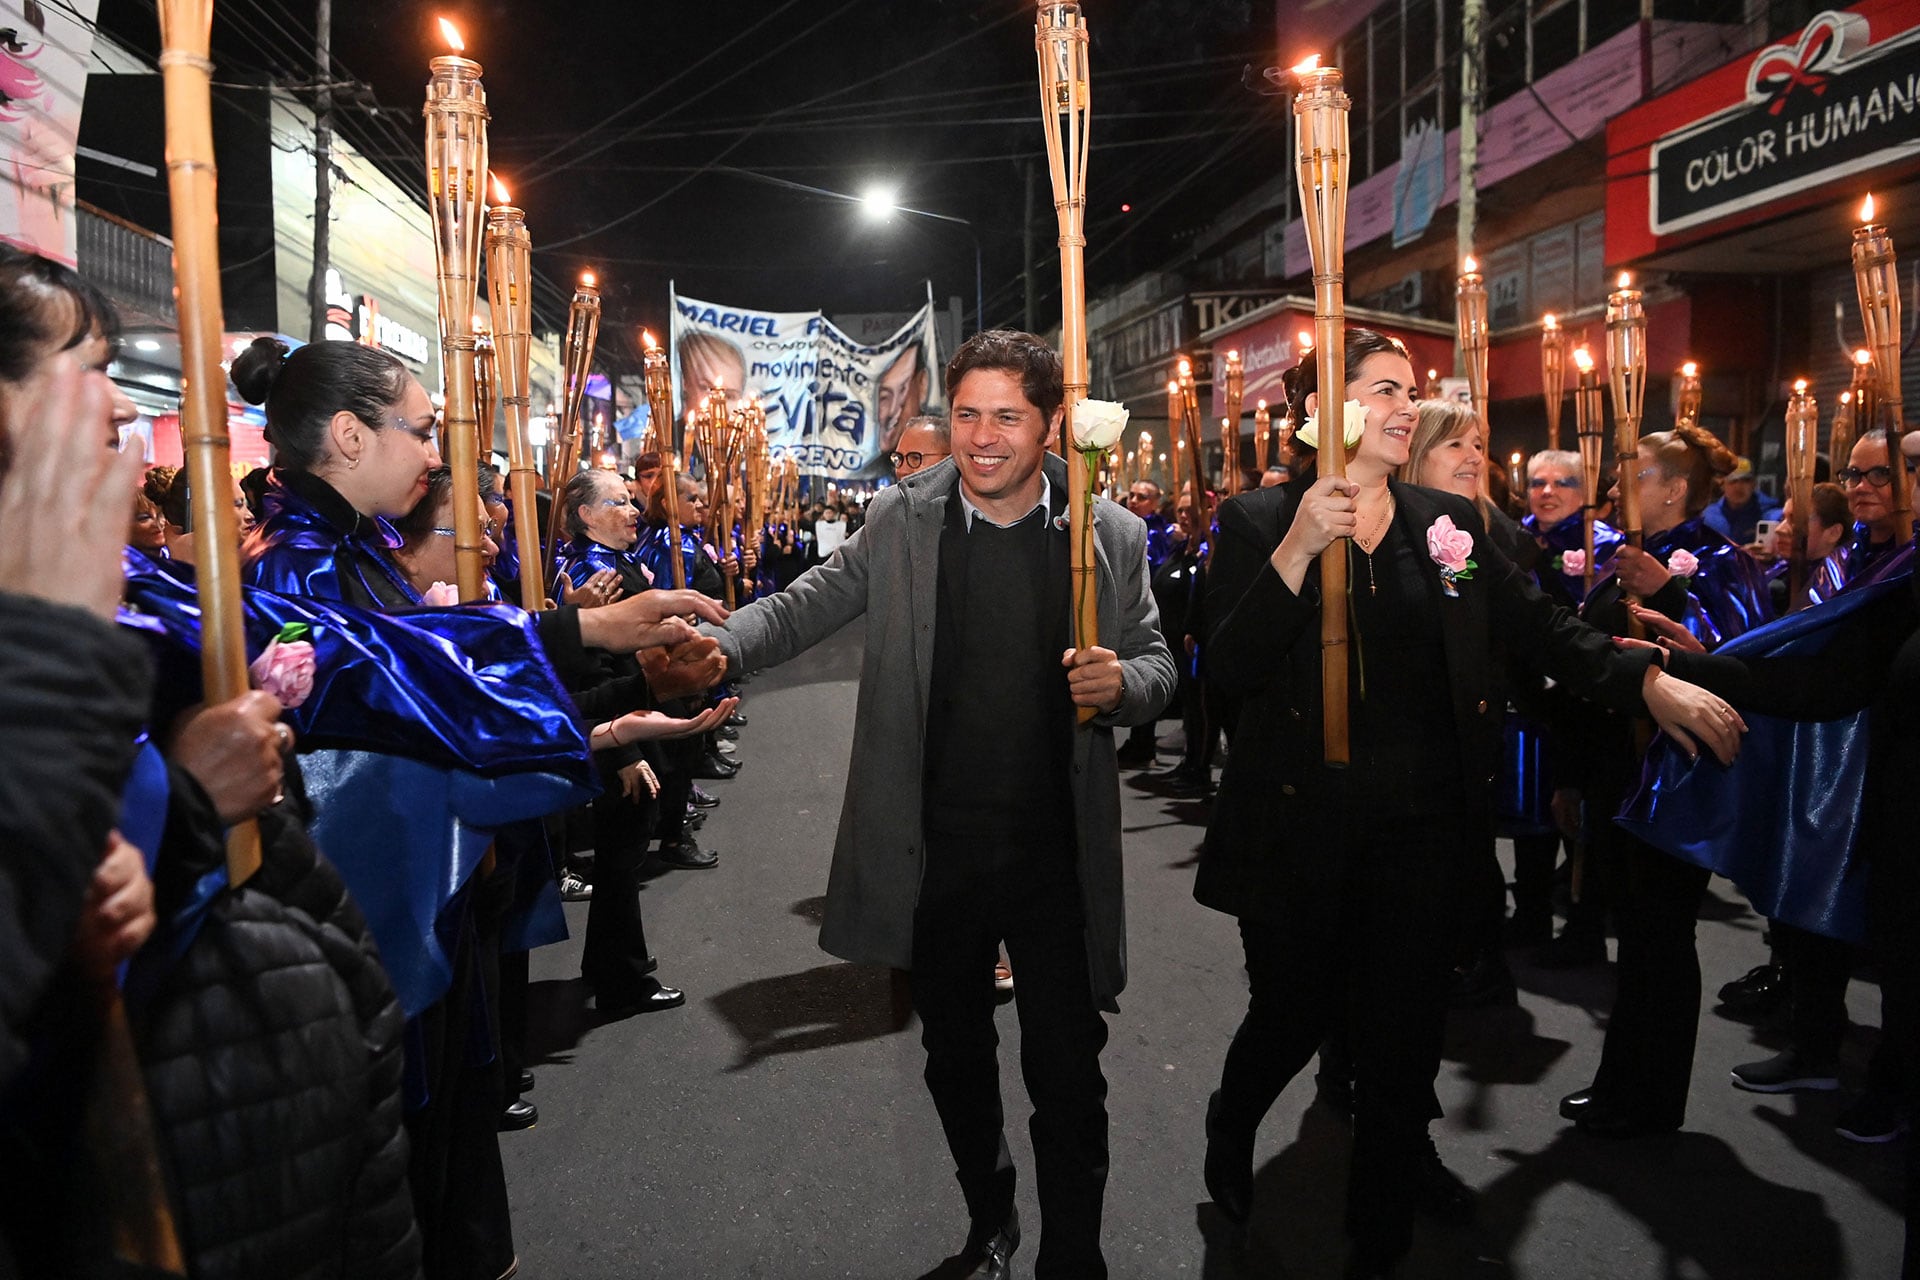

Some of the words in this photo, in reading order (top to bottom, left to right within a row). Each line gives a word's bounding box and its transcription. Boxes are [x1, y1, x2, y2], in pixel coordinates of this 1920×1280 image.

[1685, 129, 1777, 193] COLOR
[1786, 73, 1920, 157] HUMAN
[676, 301, 780, 337] MARIEL
[767, 444, 862, 470] ORENO
